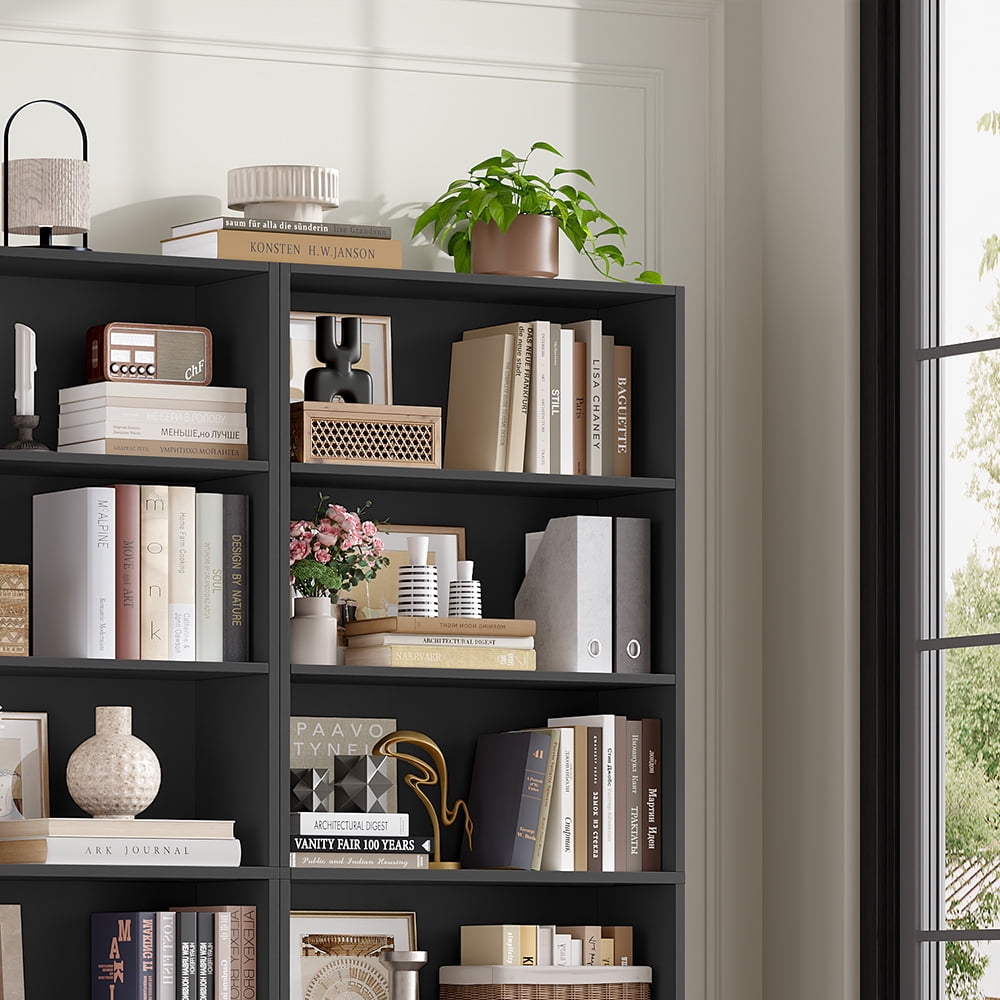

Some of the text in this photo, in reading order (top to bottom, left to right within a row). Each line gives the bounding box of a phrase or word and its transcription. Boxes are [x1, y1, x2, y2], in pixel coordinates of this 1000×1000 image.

[263, 221, 277, 229] alla
[280, 222, 292, 230] die
[521, 368, 531, 415] FRANKFURT
[552, 389, 560, 415] STILL
[618, 377, 626, 453] BAGUETTE
[213, 569, 221, 593] SOUL
[232, 535, 241, 626] DESIGN BY NATURE
[296, 722, 383, 738] PAAVO
[314, 820, 388, 831] ARCHITECTURAL DIGEST
[631, 806, 639, 855] ТРАКТАТЫ
[647, 788, 657, 849] Мартин Иден
[85, 846, 190, 855] ARK JOURNAL
[294, 838, 415, 850] VANITY FAIR 100 YEARS
